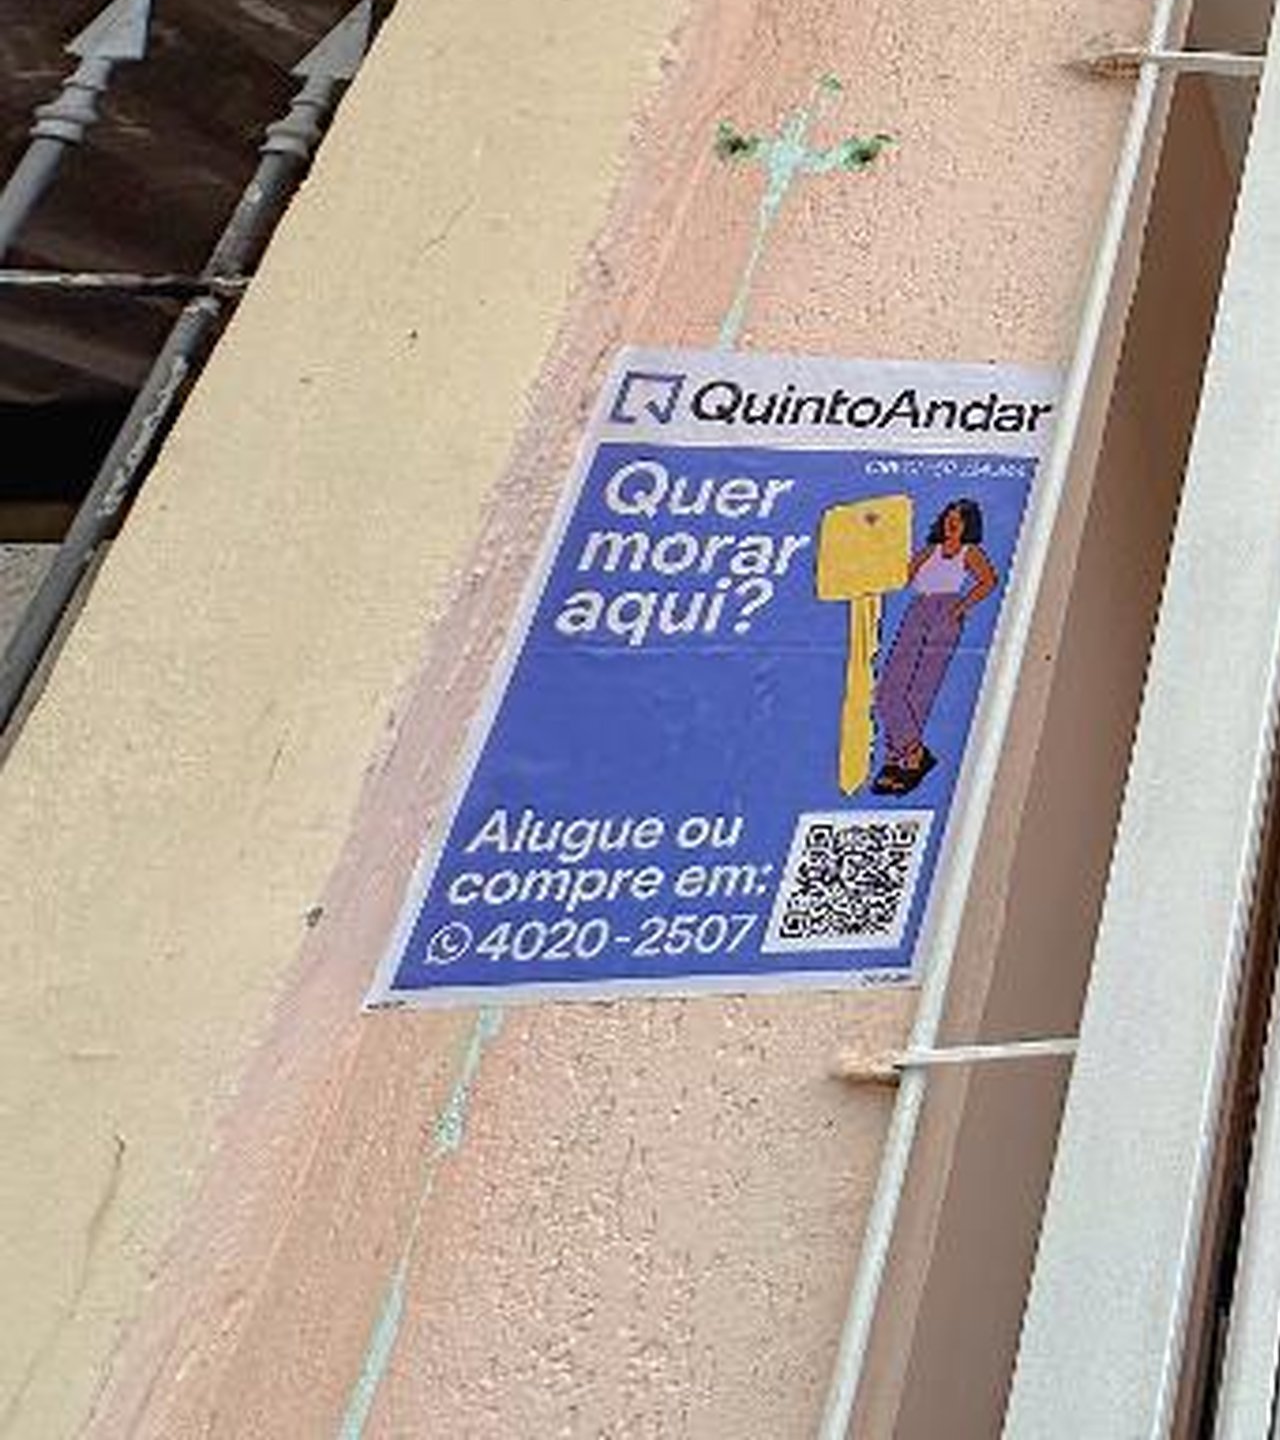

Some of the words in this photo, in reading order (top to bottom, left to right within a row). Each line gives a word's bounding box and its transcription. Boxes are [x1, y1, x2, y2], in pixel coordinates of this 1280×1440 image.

[691, 380, 1052, 432] QuintoAndar
[605, 460, 796, 519] Quer
[576, 530, 811, 576] morar
[554, 577, 774, 646] aqui?
[465, 809, 665, 862] Alugue
[676, 816, 744, 849] ou
[449, 865, 665, 912] compre
[674, 863, 774, 898] em:
